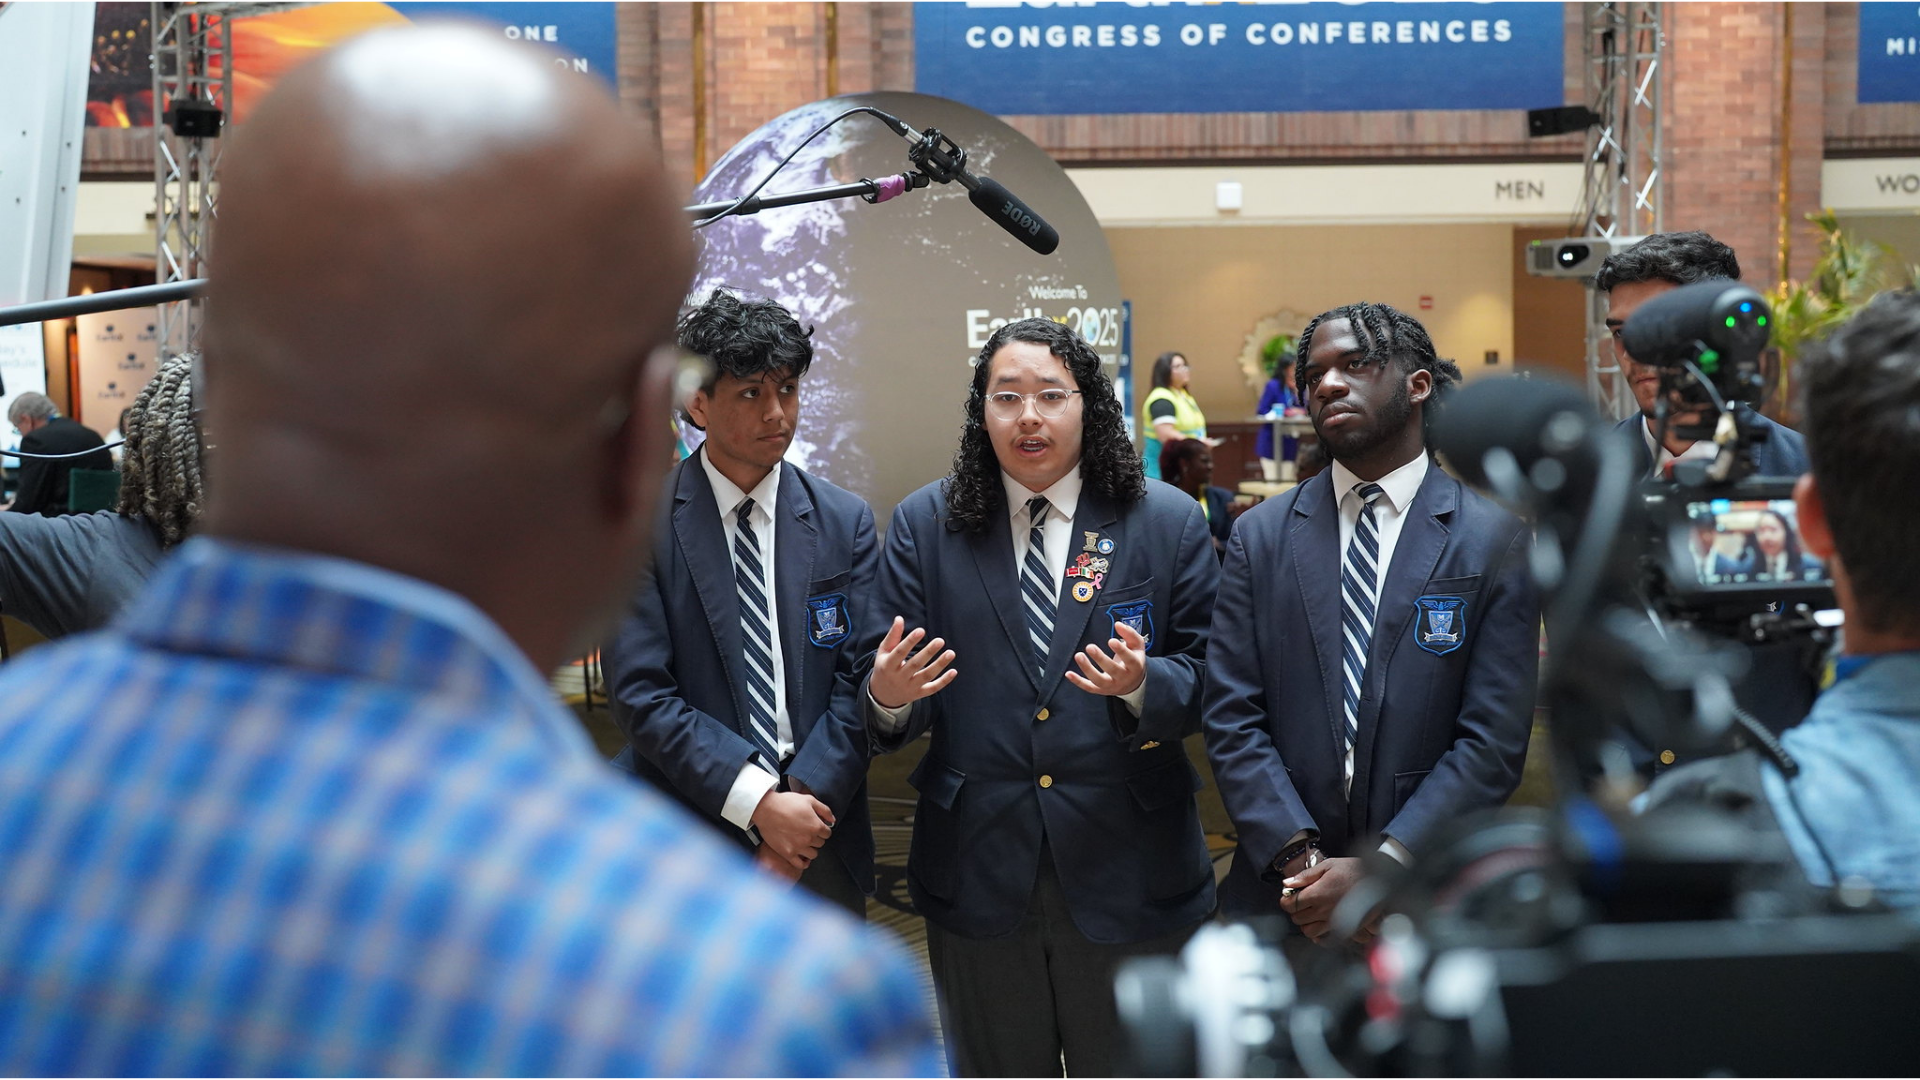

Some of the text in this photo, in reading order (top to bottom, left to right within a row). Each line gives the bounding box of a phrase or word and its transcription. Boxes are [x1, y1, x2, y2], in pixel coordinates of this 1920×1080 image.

[504, 25, 558, 41] ONE
[966, 20, 1512, 48] CONGRESS OF CONFERENCES
[1886, 37, 1920, 56] MI
[1495, 180, 1544, 200] MEN
[1001, 201, 1041, 236] RØDE
[1028, 285, 1088, 300] Welcome To
